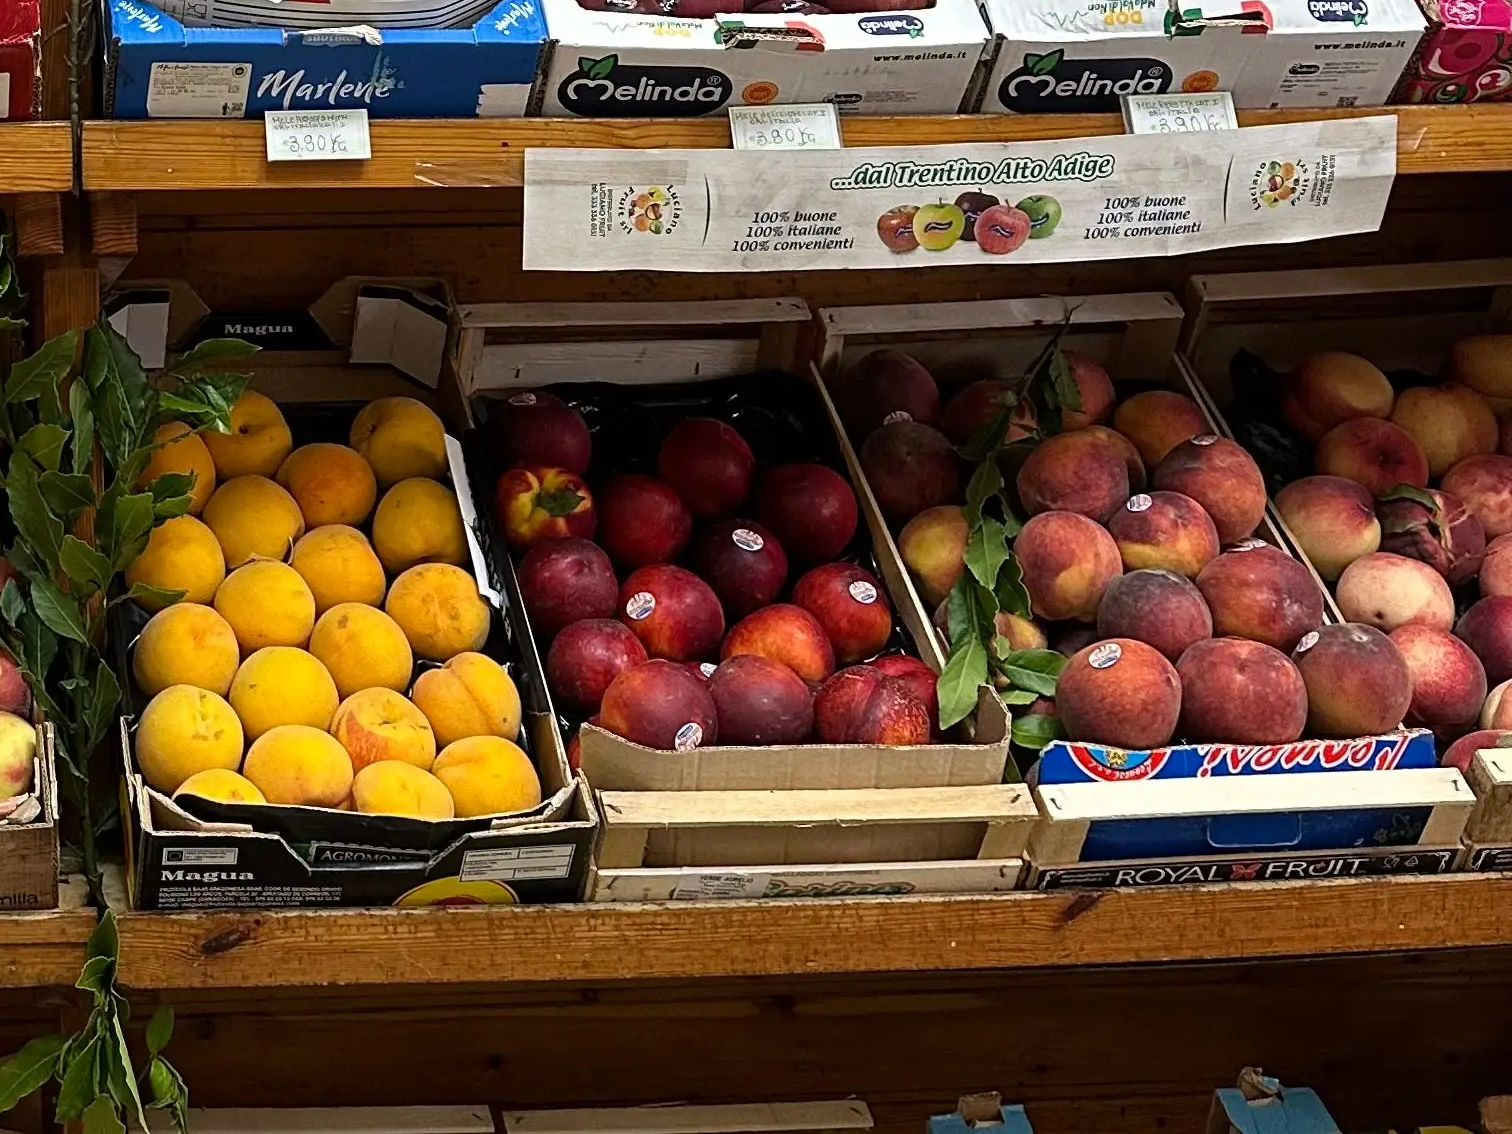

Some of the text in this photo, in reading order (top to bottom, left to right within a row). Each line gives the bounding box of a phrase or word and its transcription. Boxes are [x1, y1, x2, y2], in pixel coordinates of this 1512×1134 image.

[860, 17, 921, 34] Melinda
[1103, 11, 1143, 26] DOP
[1314, 38, 1407, 52] www.melinda.it
[873, 52, 968, 63] www.melinda.it
[256, 69, 393, 106] Marlene
[567, 75, 724, 105] Melinda
[1007, 67, 1164, 99] Melinda
[894, 160, 992, 188] Trentino
[995, 157, 1046, 182] Alto
[1046, 153, 1115, 181] Adige
[1248, 162, 1267, 212] Luciano
[617, 186, 636, 235] Fruit srl
[665, 184, 683, 235] Luciano
[1104, 195, 1187, 210] 100% buone
[751, 208, 838, 225] 100% buone
[1097, 209, 1191, 225] 100% italiane
[746, 222, 843, 238] 100% italiane
[1084, 222, 1202, 240] 100% convenienti
[731, 236, 855, 253] 100% convenienti
[224, 323, 294, 336] Magua
[160, 869, 256, 883] Magua
[1115, 864, 1224, 887] ROYAL
[1263, 857, 1370, 879] FRUIT
